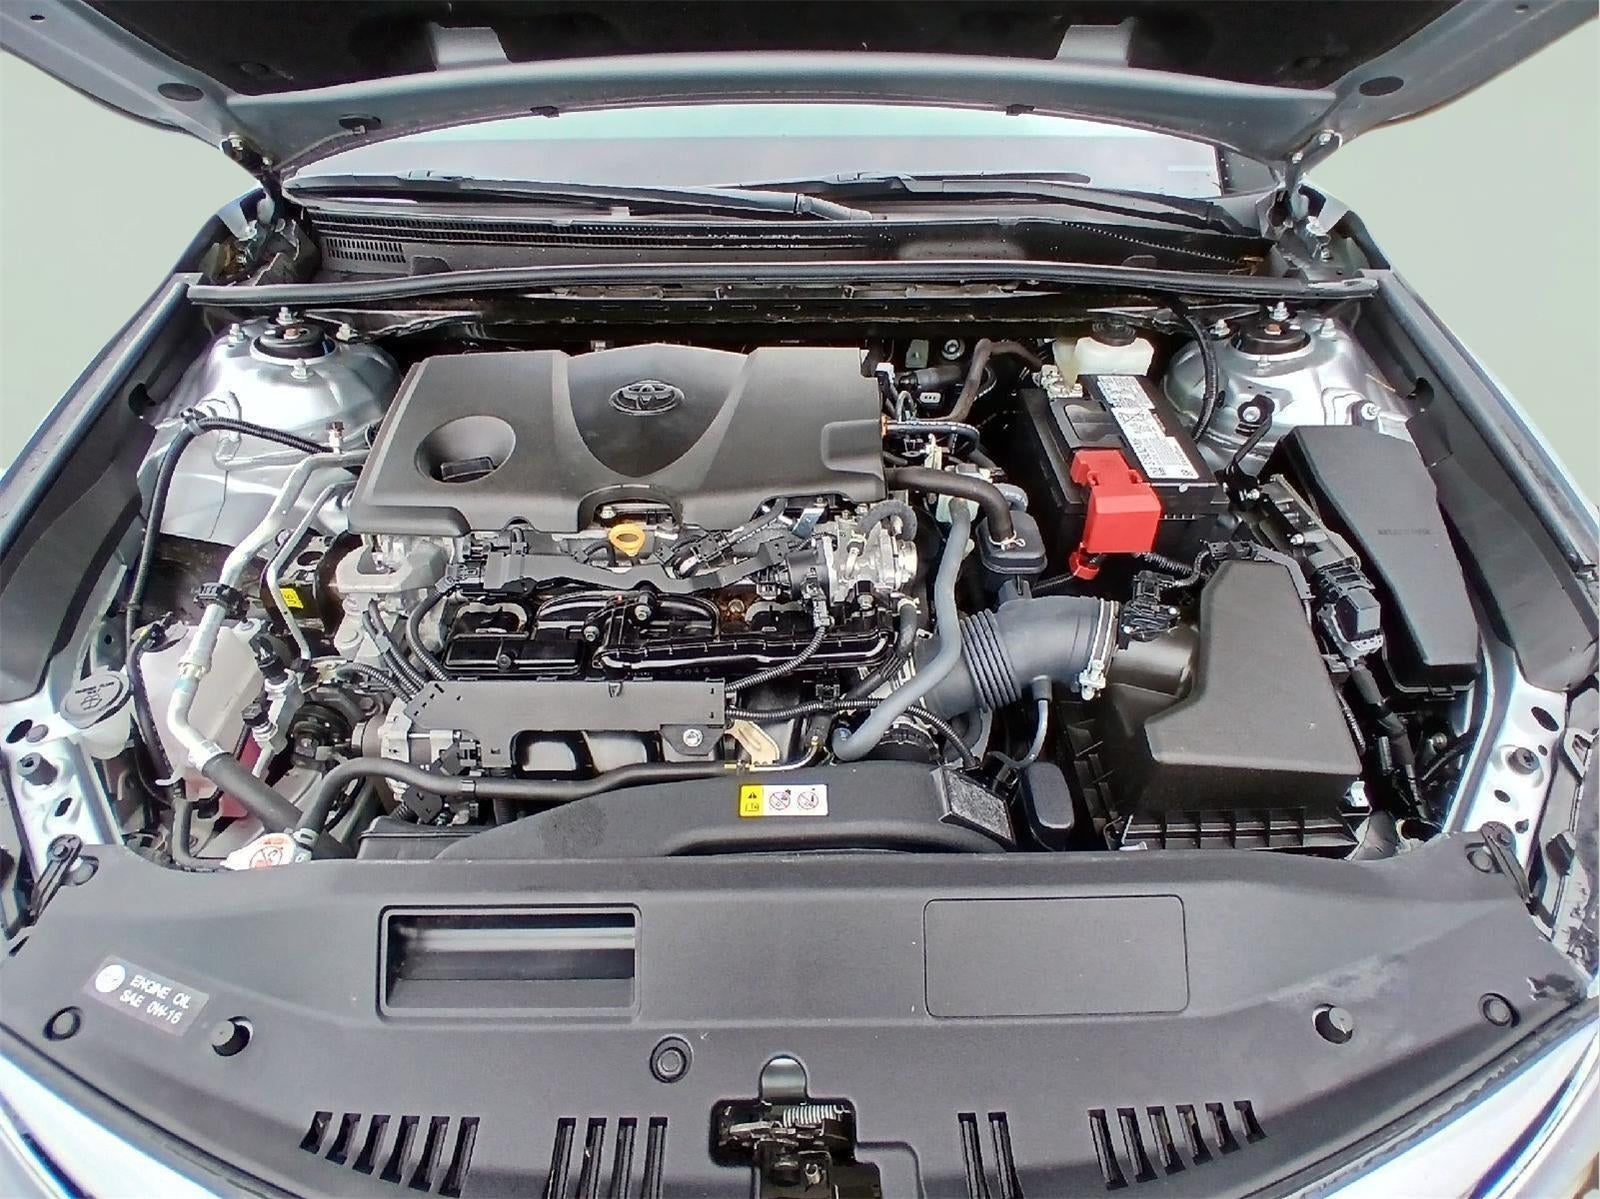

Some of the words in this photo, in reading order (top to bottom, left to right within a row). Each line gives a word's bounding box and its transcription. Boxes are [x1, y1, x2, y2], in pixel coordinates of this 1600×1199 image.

[119, 989, 145, 1008] SAE
[130, 974, 172, 1000] ENGINE
[172, 992, 192, 1009] OIL
